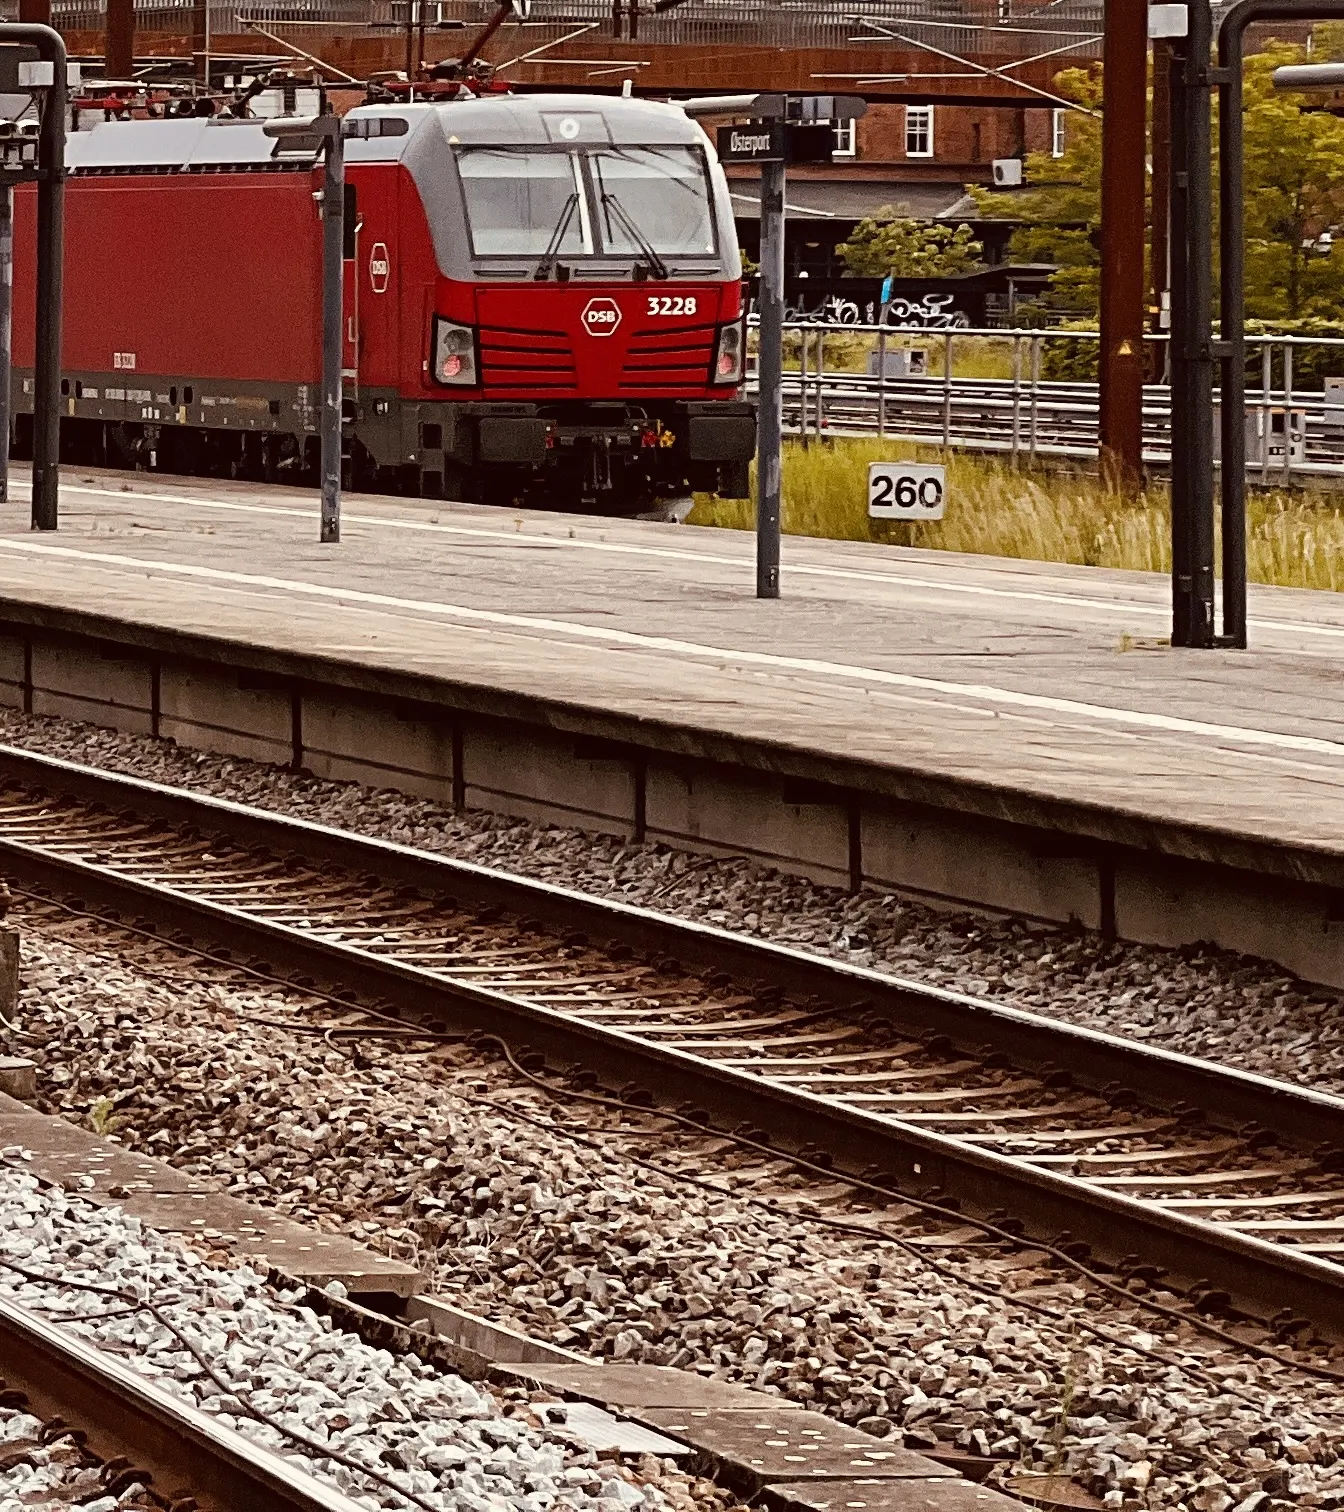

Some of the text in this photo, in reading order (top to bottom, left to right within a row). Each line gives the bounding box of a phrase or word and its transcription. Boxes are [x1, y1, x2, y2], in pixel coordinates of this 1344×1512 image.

[372, 260, 387, 275] DSB
[646, 296, 697, 316] 3228
[587, 310, 616, 323] DSB
[871, 475, 943, 508] 260
